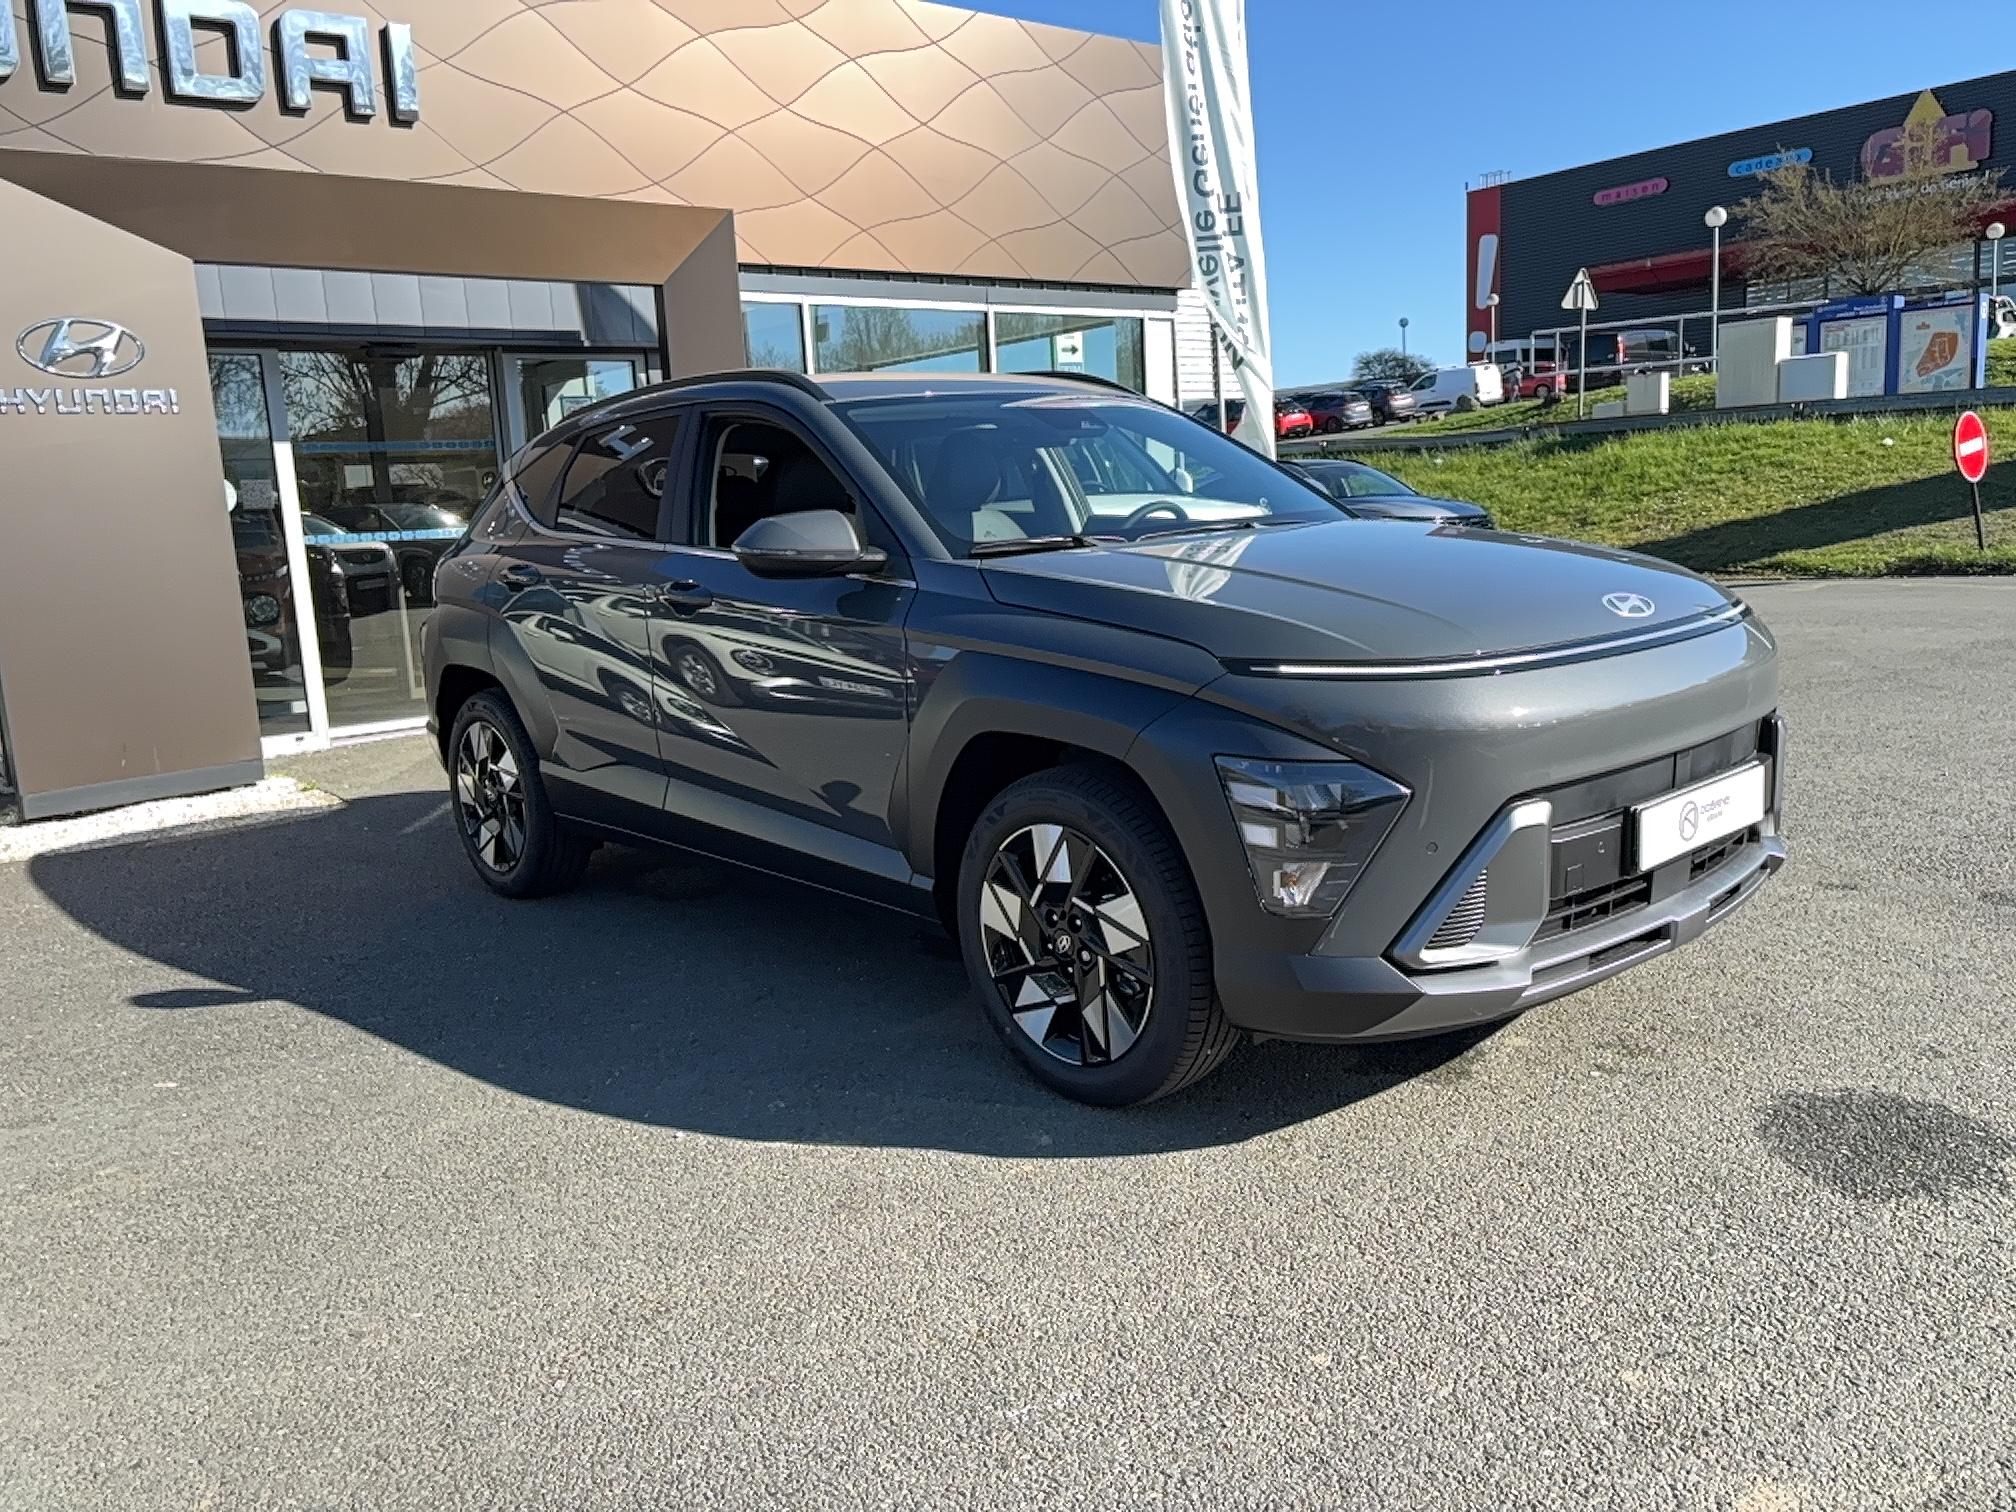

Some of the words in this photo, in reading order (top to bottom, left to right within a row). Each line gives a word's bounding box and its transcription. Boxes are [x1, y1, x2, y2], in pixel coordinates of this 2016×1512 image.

[1736, 154, 1802, 174] cadex
[1601, 182, 1659, 202] maison
[0, 388, 181, 414] HYUNDAI
